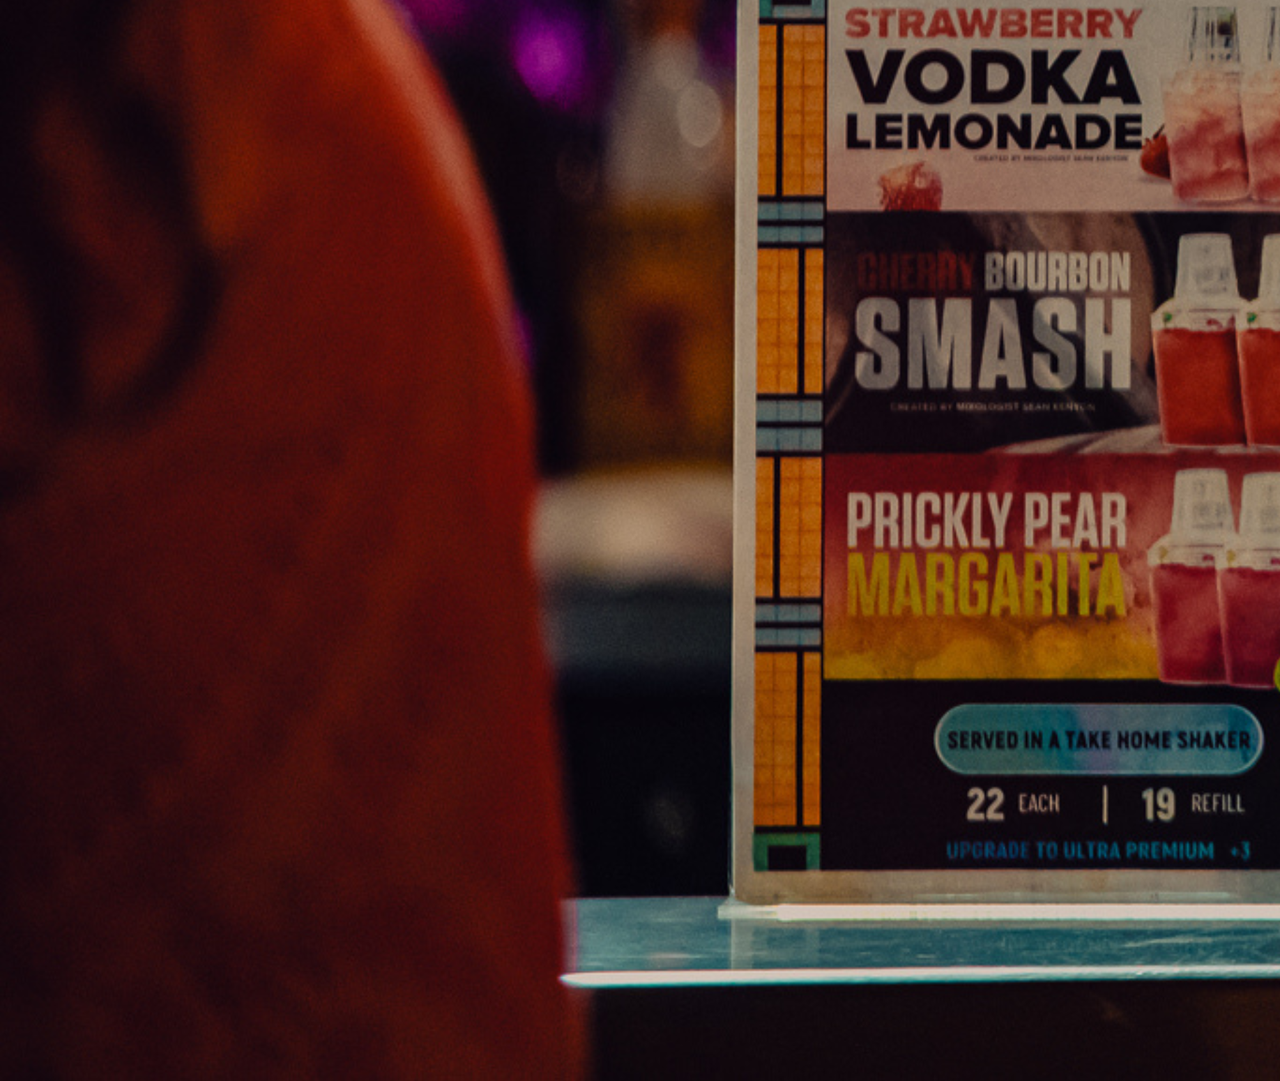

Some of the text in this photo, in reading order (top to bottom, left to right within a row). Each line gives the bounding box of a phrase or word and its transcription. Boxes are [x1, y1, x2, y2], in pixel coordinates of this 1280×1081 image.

[845, 7, 1143, 39] STRAWBERRY
[845, 48, 1142, 105] VODKA
[846, 112, 1143, 150] LEMONADE
[857, 250, 1131, 292] CHERRY BOURBON
[854, 297, 1132, 391] SMASH
[889, 401, 937, 412] CREATED
[940, 401, 952, 412] BY
[956, 401, 1019, 412] MIXOLOGIST
[1022, 401, 1050, 412] SEAN
[847, 491, 1127, 549] PRICKLY PEAR
[847, 552, 1127, 617] MARGARITA
[947, 730, 1251, 750] SERVED IN A TAKE HOME SHAKER
[966, 787, 1246, 821] 22 EACH 19 REFILL
[946, 841, 1250, 860] UPGRADE TO ULTRA PREMIUM +3
